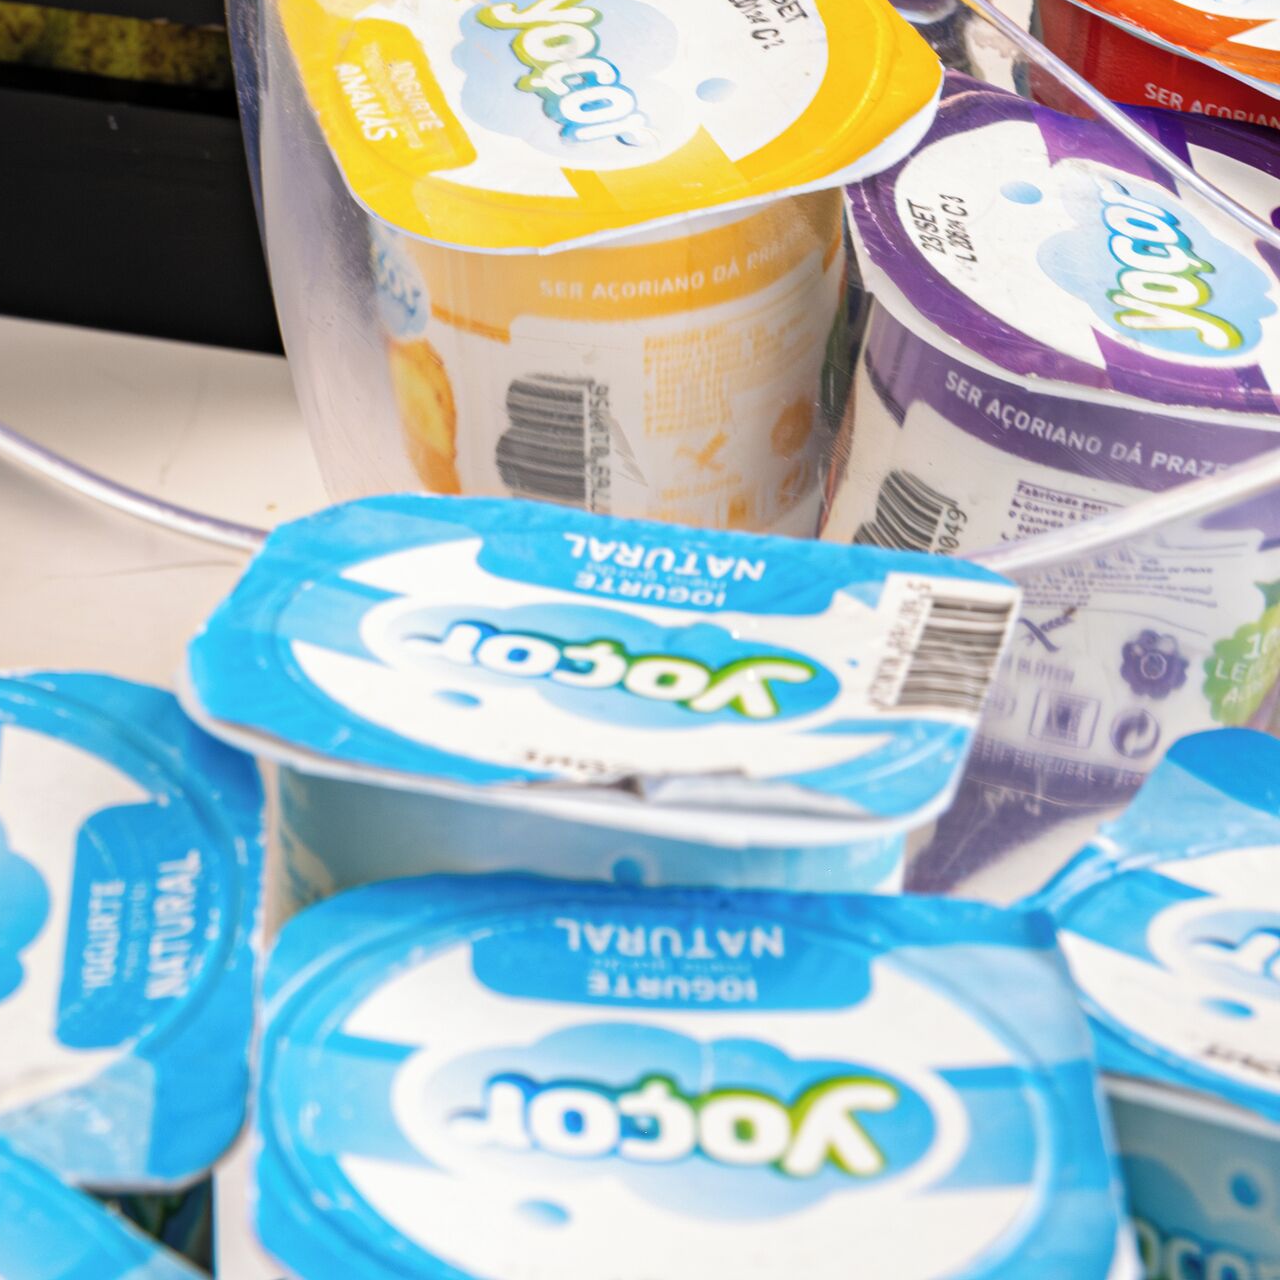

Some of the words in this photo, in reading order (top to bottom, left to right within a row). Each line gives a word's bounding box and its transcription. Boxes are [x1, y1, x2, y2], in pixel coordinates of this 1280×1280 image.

[1143, 82, 1184, 112] SER
[906, 198, 946, 254] 23/SET
[539, 278, 584, 301] SER
[591, 270, 704, 303] AÇORIANO
[945, 370, 981, 408] SER
[986, 397, 1102, 456] AÇORIANO
[1110, 441, 1143, 466] DÁ
[1150, 451, 1232, 478] PRAZE
[563, 532, 766, 582] NATURAL
[574, 570, 727, 608] IOGURTE
[145, 847, 202, 1001] NATURAL
[555, 917, 784, 959] NATURAL
[586, 970, 758, 1003] IOGURTE
